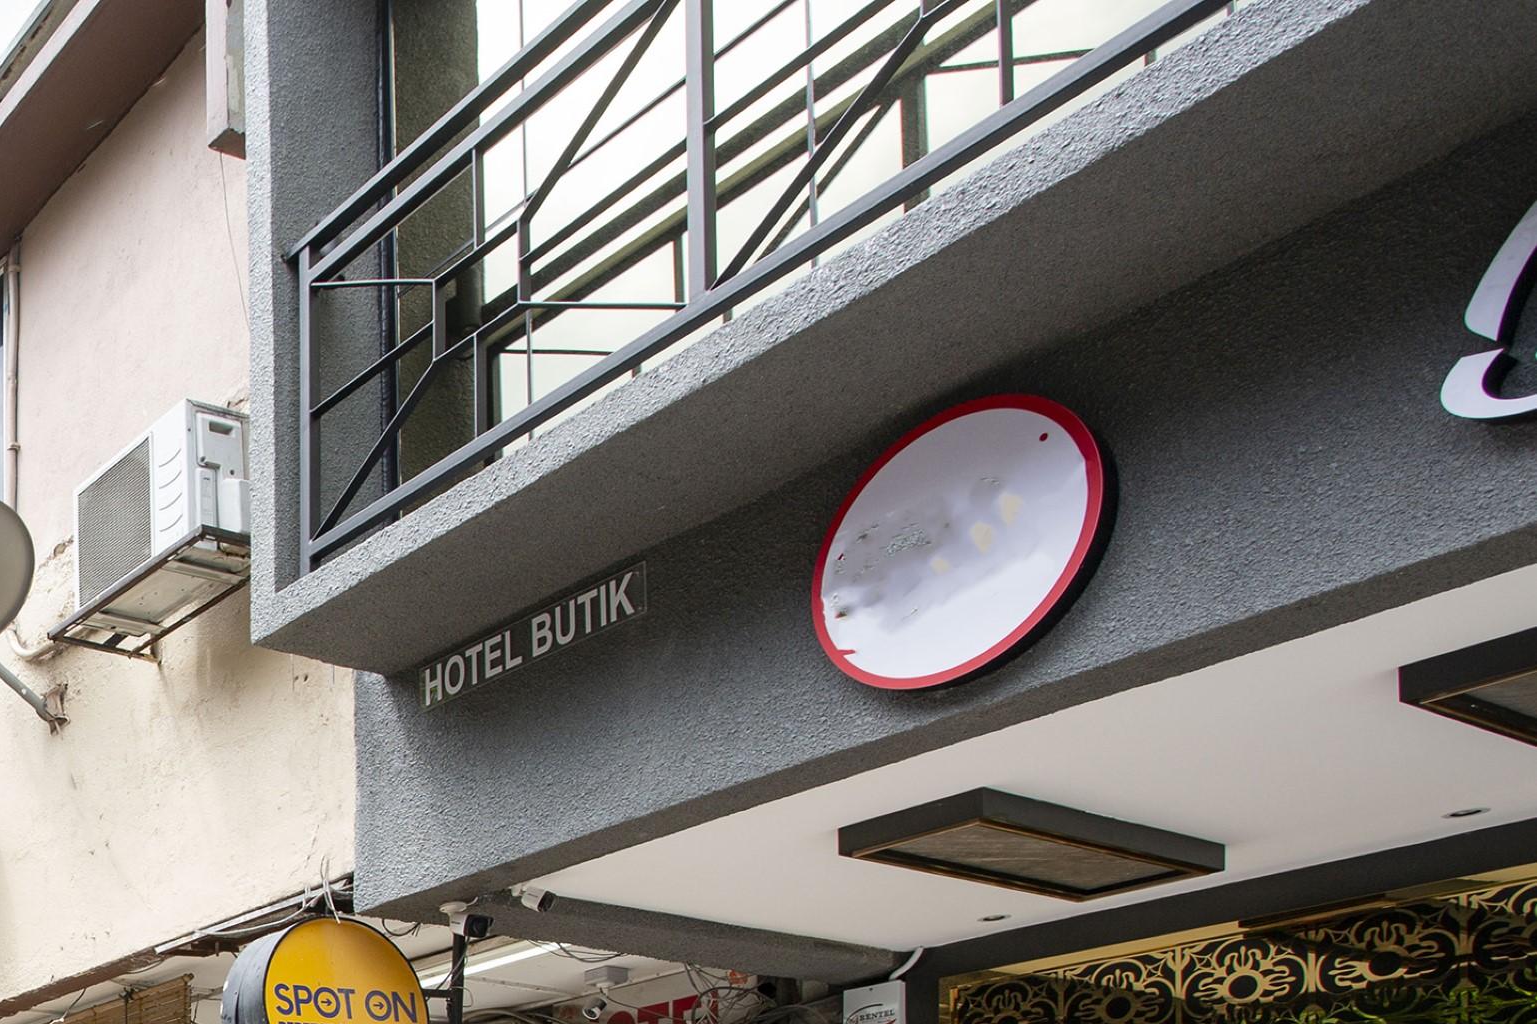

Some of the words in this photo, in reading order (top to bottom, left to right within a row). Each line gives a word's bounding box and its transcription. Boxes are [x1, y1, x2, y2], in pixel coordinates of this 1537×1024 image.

[424, 630, 523, 707] HOTEL
[531, 571, 636, 658] BUTIK
[274, 983, 355, 1019] SPOT
[365, 990, 418, 1023] ON
